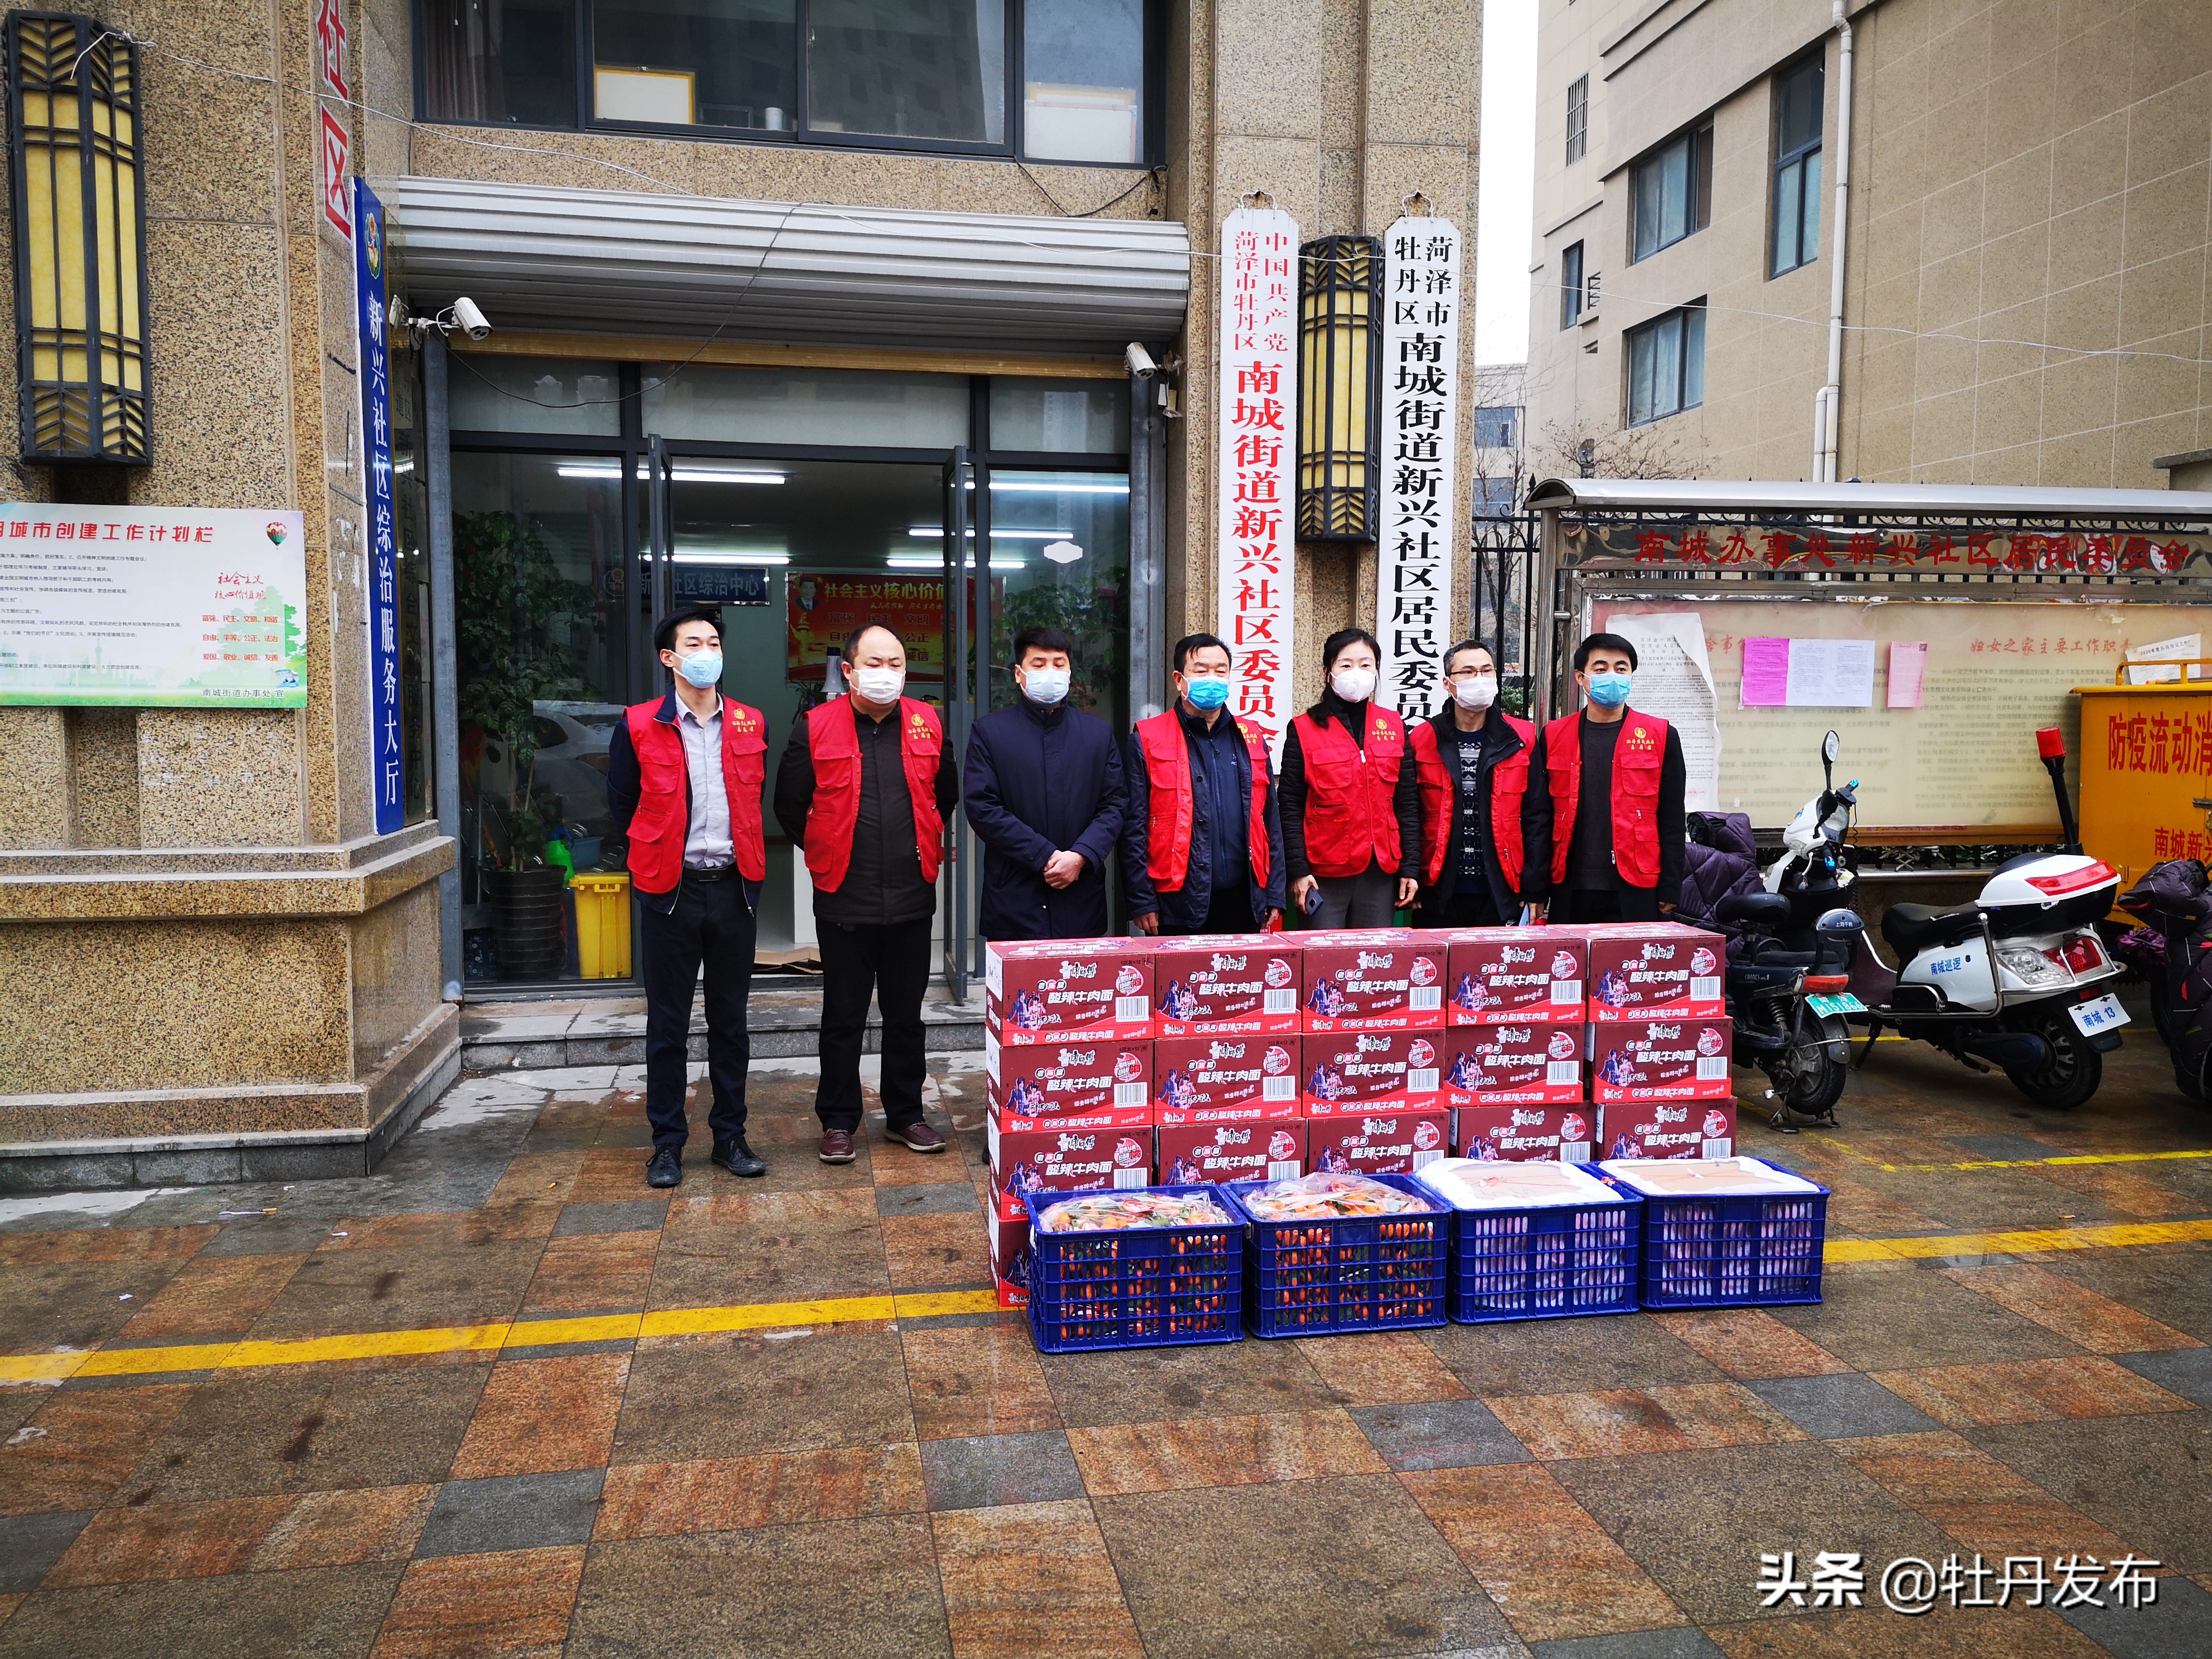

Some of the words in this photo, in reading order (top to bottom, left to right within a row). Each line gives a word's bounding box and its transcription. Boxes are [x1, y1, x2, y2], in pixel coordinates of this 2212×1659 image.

[1394, 236, 1421, 325] 牡丹区
[1425, 236, 1453, 327] 菏泽市
[1234, 231, 1259, 351] 菏泽市牡丹区
[1265, 232, 1289, 352] 中国共产党
[0, 521, 214, 543] 城市创建工作计划栏
[1389, 333, 1448, 733] 南城街道新兴社区居民委员
[369, 292, 400, 807] 新兴社区综治服务大厅
[1634, 528, 2189, 572] 南城办事处新兴社区居民委员会
[218, 571, 264, 585] 社会主义
[903, 614, 930, 625] 文明
[904, 632, 929, 643] 公正
[202, 688, 271, 697] 南城街道办事处
[1930, 957, 1962, 976] 南城巡逻
[1488, 973, 1551, 988] 酸辣牛肉面
[1629, 969, 1690, 985] 酸辣牛肉面
[1199, 981, 1264, 997] 酸辣牛肉面
[1346, 979, 1409, 995] 酸辣牛肉面
[1047, 989, 1115, 1005] 酸辣牛肉面
[2082, 1010, 2104, 1027] 南城
[2104, 1007, 2116, 1018] 13
[1484, 1053, 1548, 1069] 酸辣牛肉面
[1636, 1049, 1697, 1065] 酸辣牛肉面
[1197, 1069, 1262, 1085] 酸辣牛肉面
[1344, 1061, 1407, 1078] 酸辣牛肉面
[1046, 1076, 1113, 1093] 酸辣牛肉面
[1500, 1134, 1560, 1151] 酸辣牛肉面
[1644, 1131, 1702, 1148] 酸辣牛肉面
[1350, 1144, 1413, 1161] 酸辣牛肉面
[1045, 1161, 1113, 1177] 酸辣牛肉面
[1203, 1154, 1268, 1171] 酸辣牛肉面
